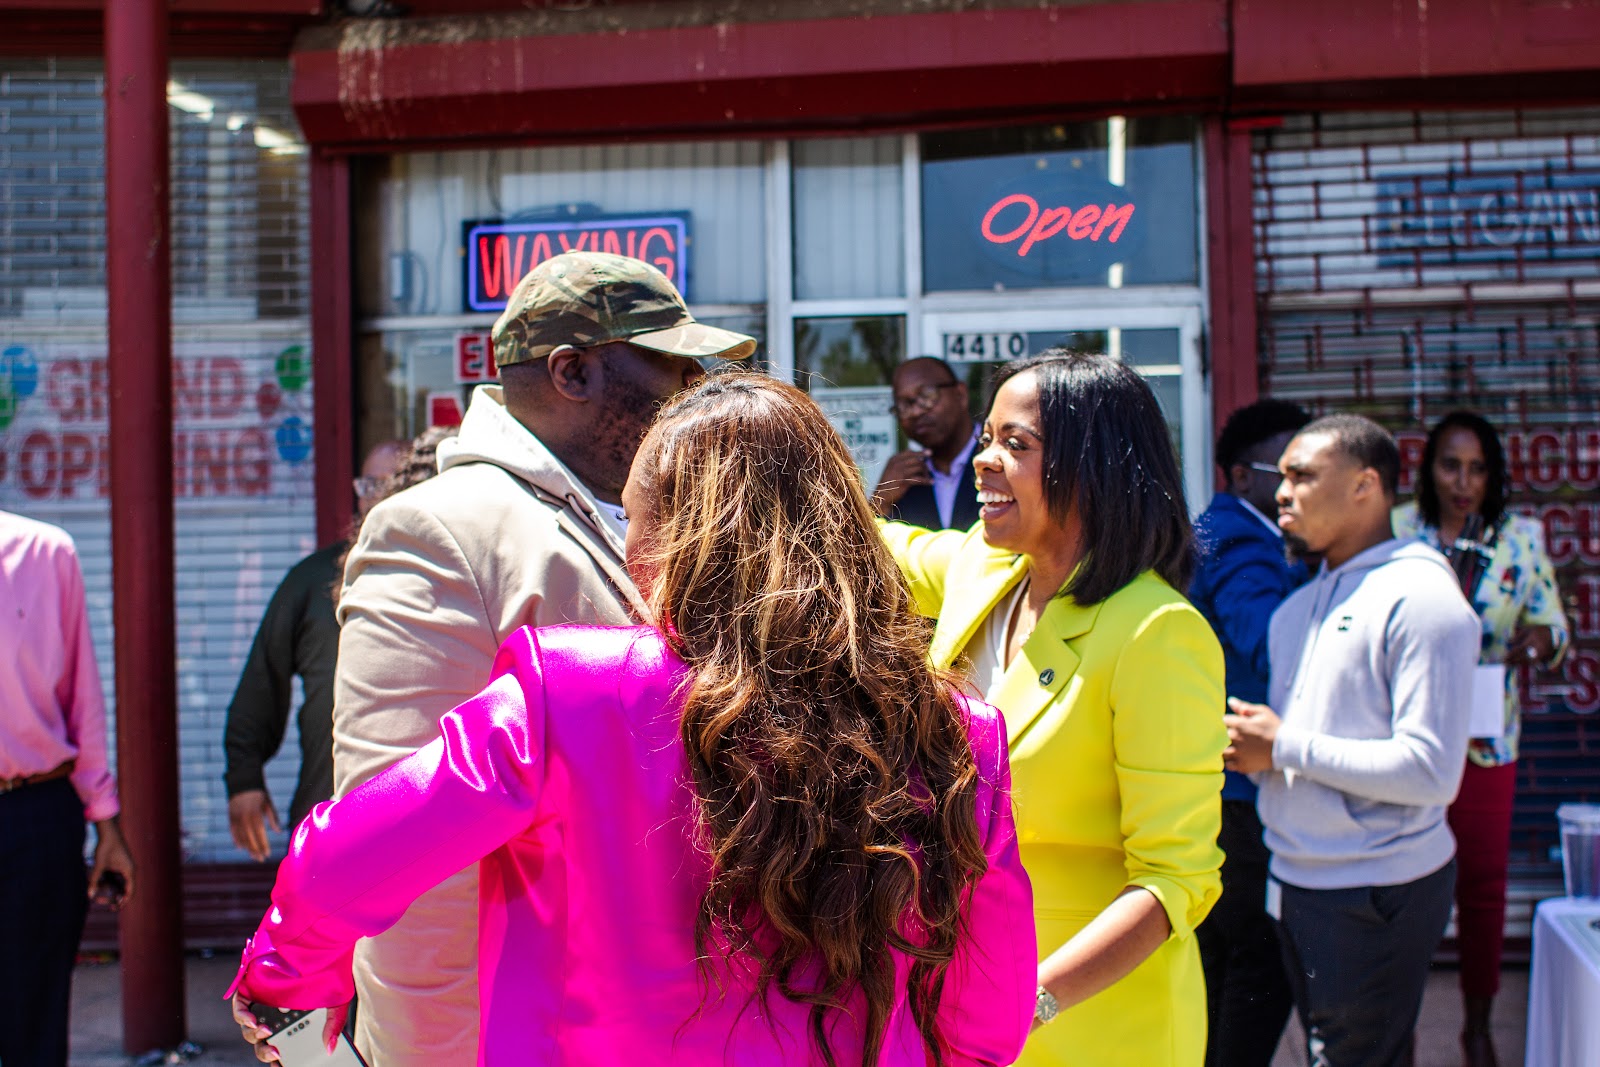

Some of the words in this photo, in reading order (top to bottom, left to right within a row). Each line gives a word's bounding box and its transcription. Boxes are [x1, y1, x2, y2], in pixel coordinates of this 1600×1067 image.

[981, 193, 1136, 257] Open
[950, 333, 1026, 358] 4410
[48, 356, 244, 422] GND
[19, 428, 272, 499] OPING
